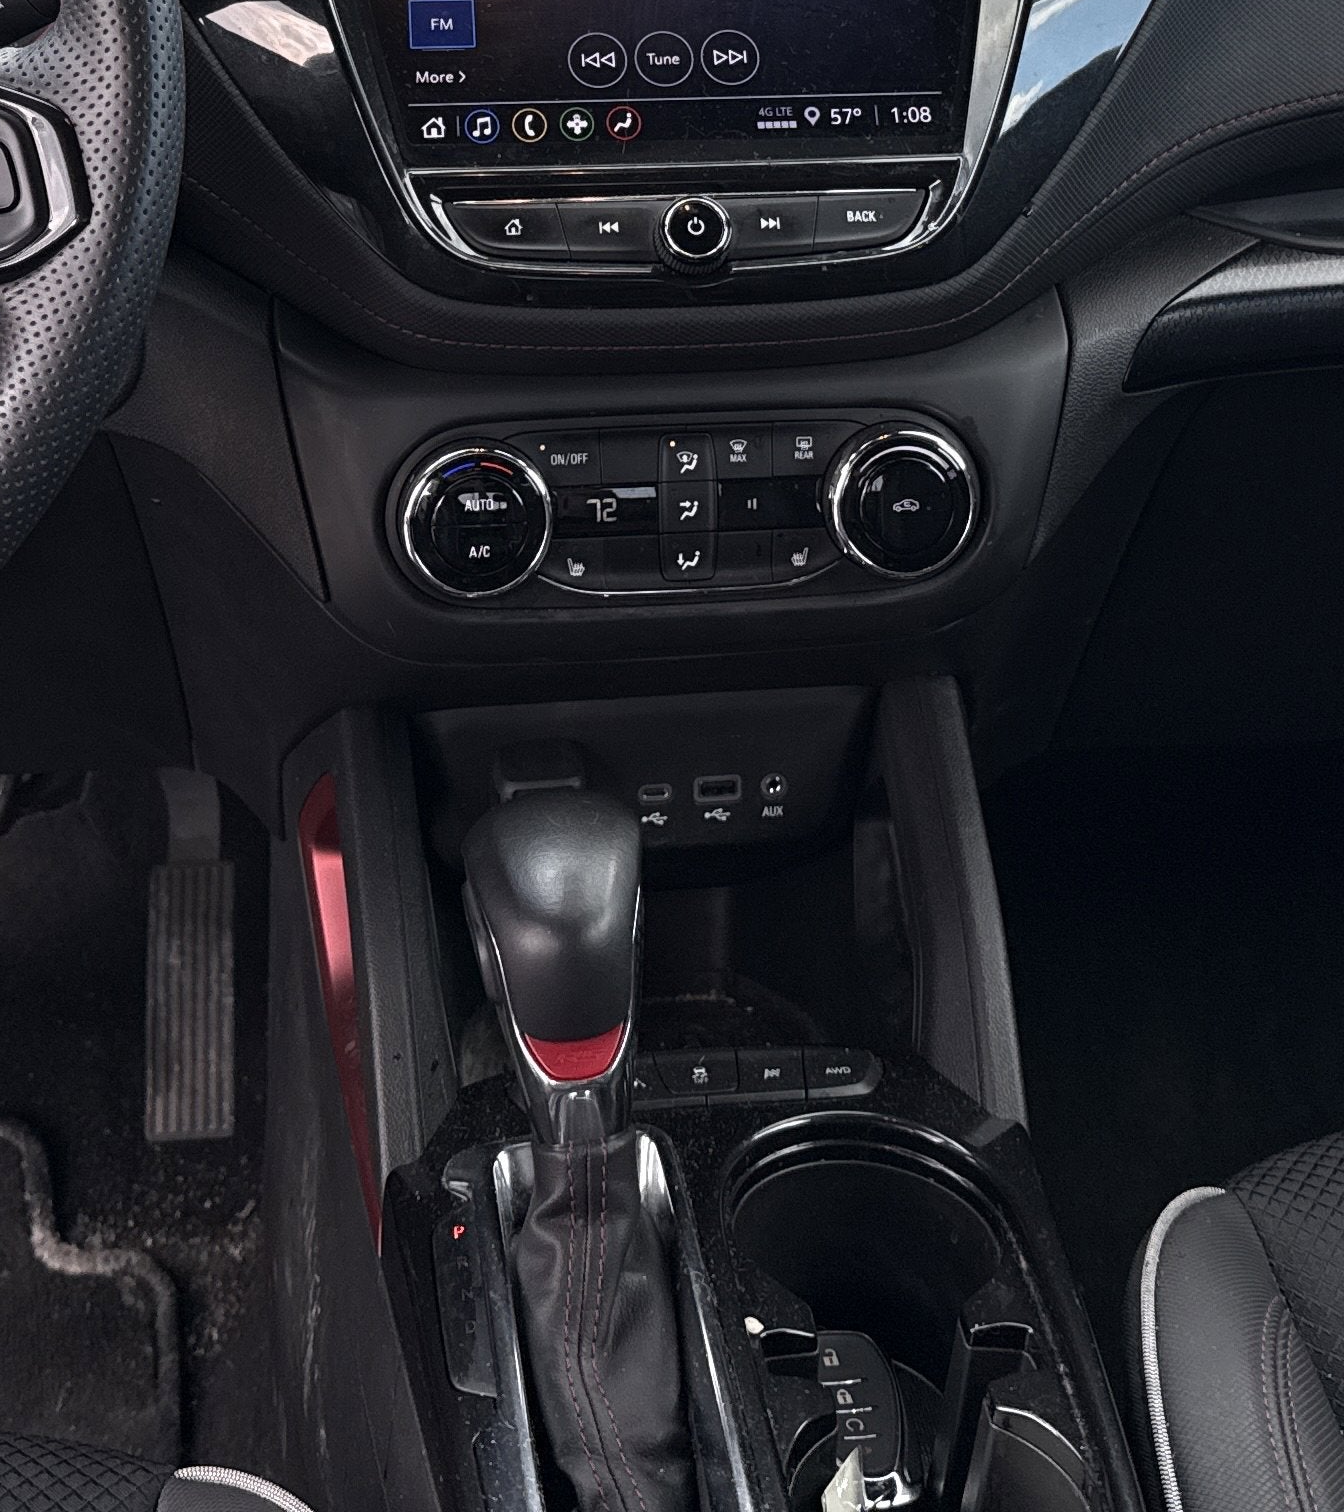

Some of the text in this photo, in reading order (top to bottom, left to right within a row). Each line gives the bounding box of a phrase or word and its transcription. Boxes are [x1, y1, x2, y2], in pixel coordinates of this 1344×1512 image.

[430, 18, 454, 31] FM
[646, 53, 680, 65] Tune
[415, 71, 454, 83] More
[759, 107, 793, 117] 4G LTE
[830, 108, 861, 125] 57°
[891, 106, 932, 123] 1:08
[846, 210, 877, 223] BACK
[550, 453, 589, 466] ON/OFF
[729, 453, 747, 463] MAX
[794, 451, 814, 460] REAR
[464, 498, 494, 512] AUTO
[587, 497, 617, 522] 72
[469, 545, 491, 558] A/C
[761, 806, 784, 817] AUX
[825, 1066, 851, 1075] AWD
[453, 1225, 465, 1239] P
